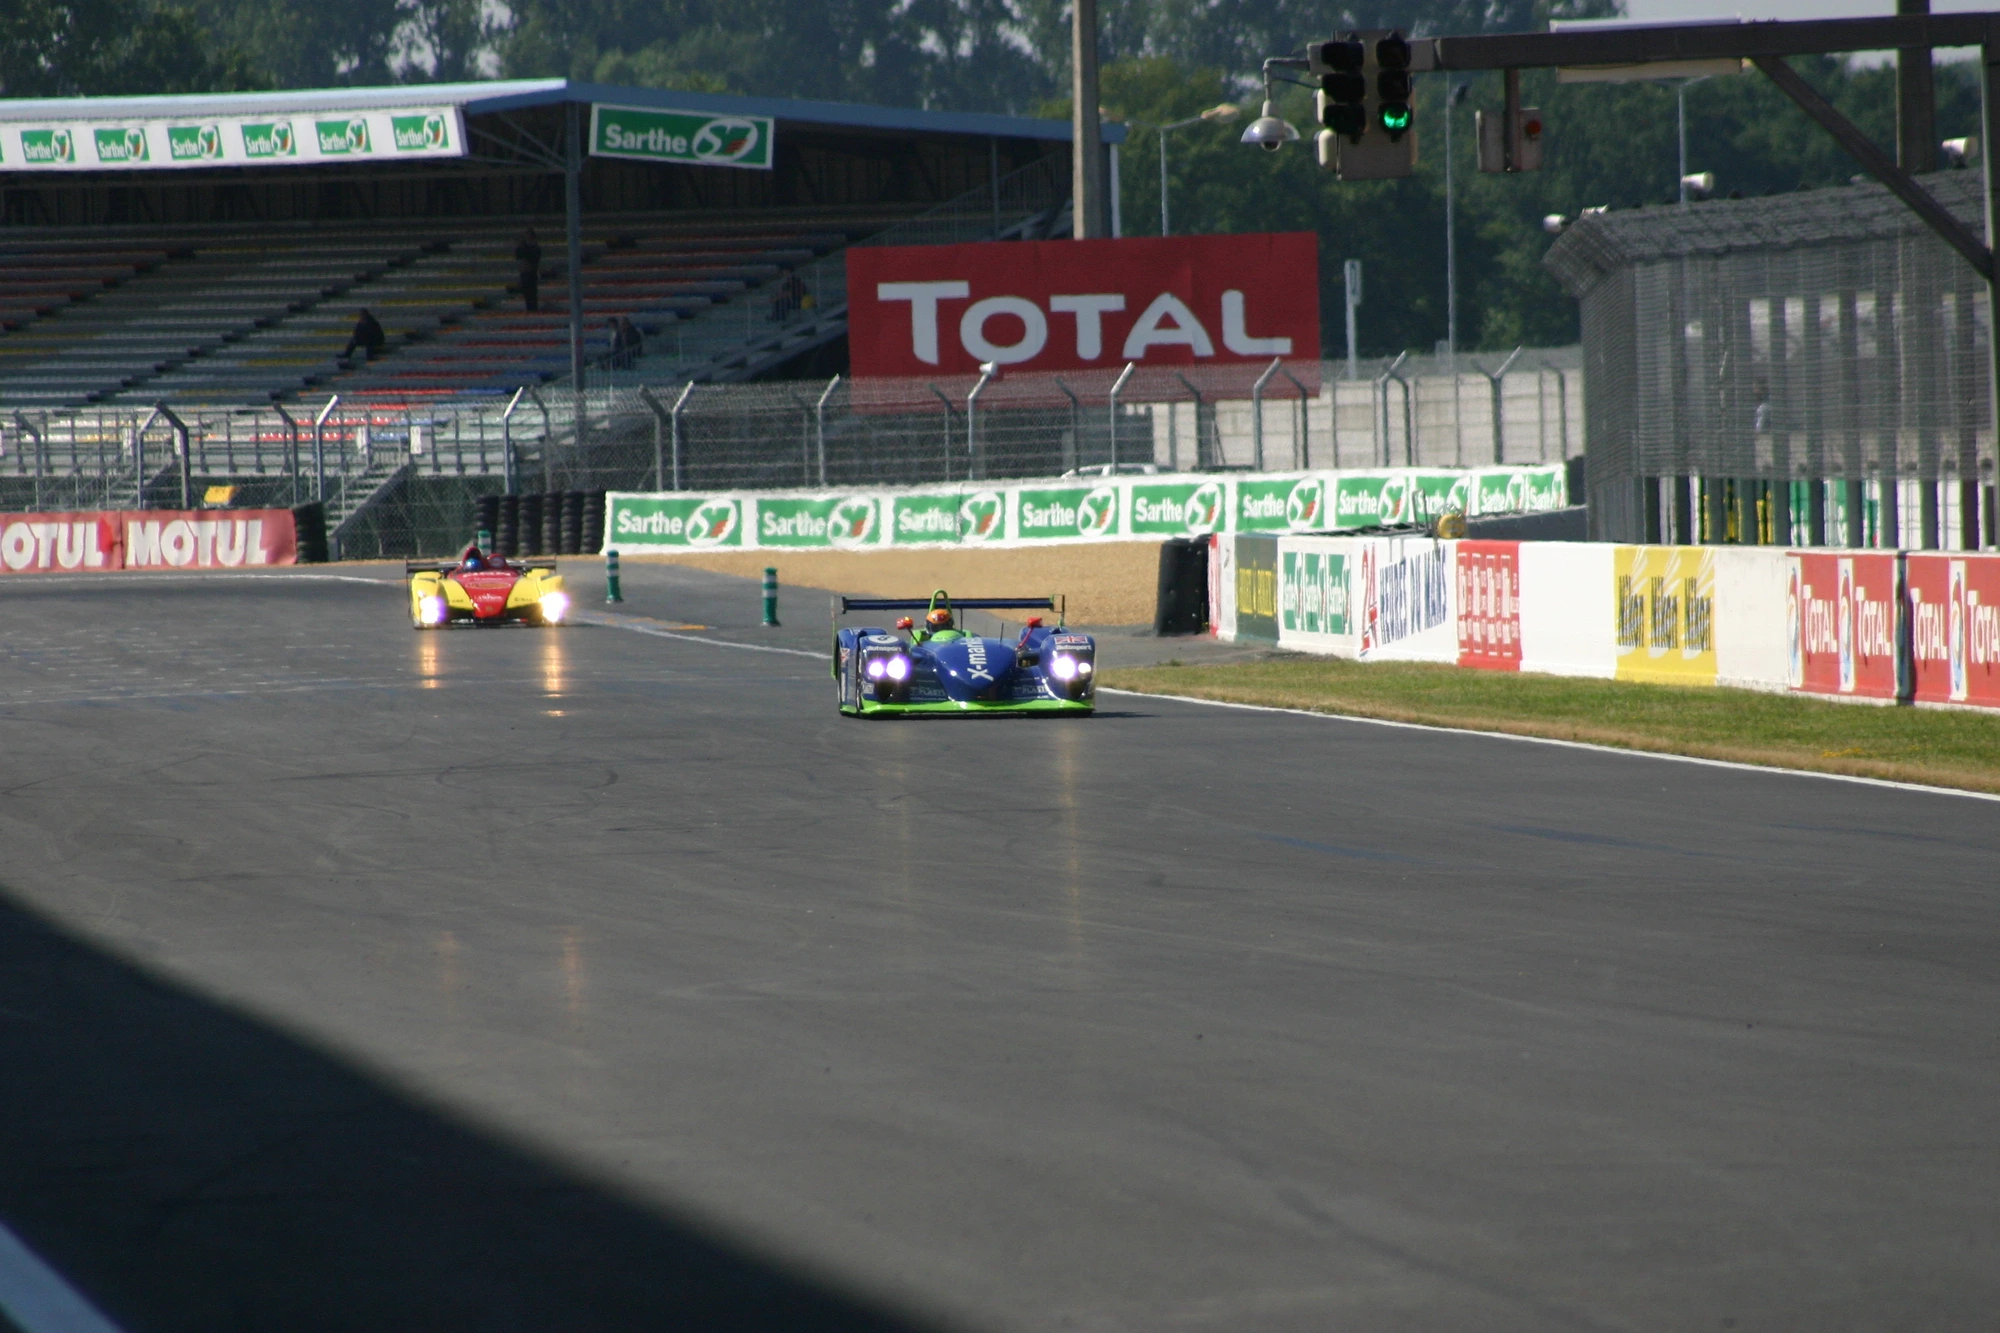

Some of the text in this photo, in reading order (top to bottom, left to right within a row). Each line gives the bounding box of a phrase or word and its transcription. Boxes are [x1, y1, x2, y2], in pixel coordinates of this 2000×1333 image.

[24, 140, 51, 161] Sarthe
[98, 139, 125, 160] Sarthe
[172, 137, 199, 157] Sarthe
[245, 135, 272, 155] Sarthe
[319, 133, 347, 154] Sarthe
[395, 128, 423, 147] Sarthe
[604, 122, 687, 154] Sarthe
[877, 281, 1292, 366] TOTAL
[1023, 502, 1075, 528] Sarthe
[1136, 496, 1182, 522] Sarthe
[1242, 492, 1285, 518] Sarthe
[1338, 489, 1377, 515] Sarthe
[617, 508, 682, 535] Sarthe
[763, 511, 826, 537] Sarthe
[899, 507, 957, 534] Sarthe
[0, 521, 104, 570] OTUL
[127, 519, 268, 567] MOTUL
[1359, 543, 1378, 657] 24
[1379, 557, 1407, 645] HEURES
[1410, 554, 1421, 635] DU
[1803, 584, 1838, 654] TOTAL
[1855, 586, 1892, 656] TOTAL
[1910, 588, 1948, 660] TOTAL
[1967, 590, 2000, 664] TOTA
